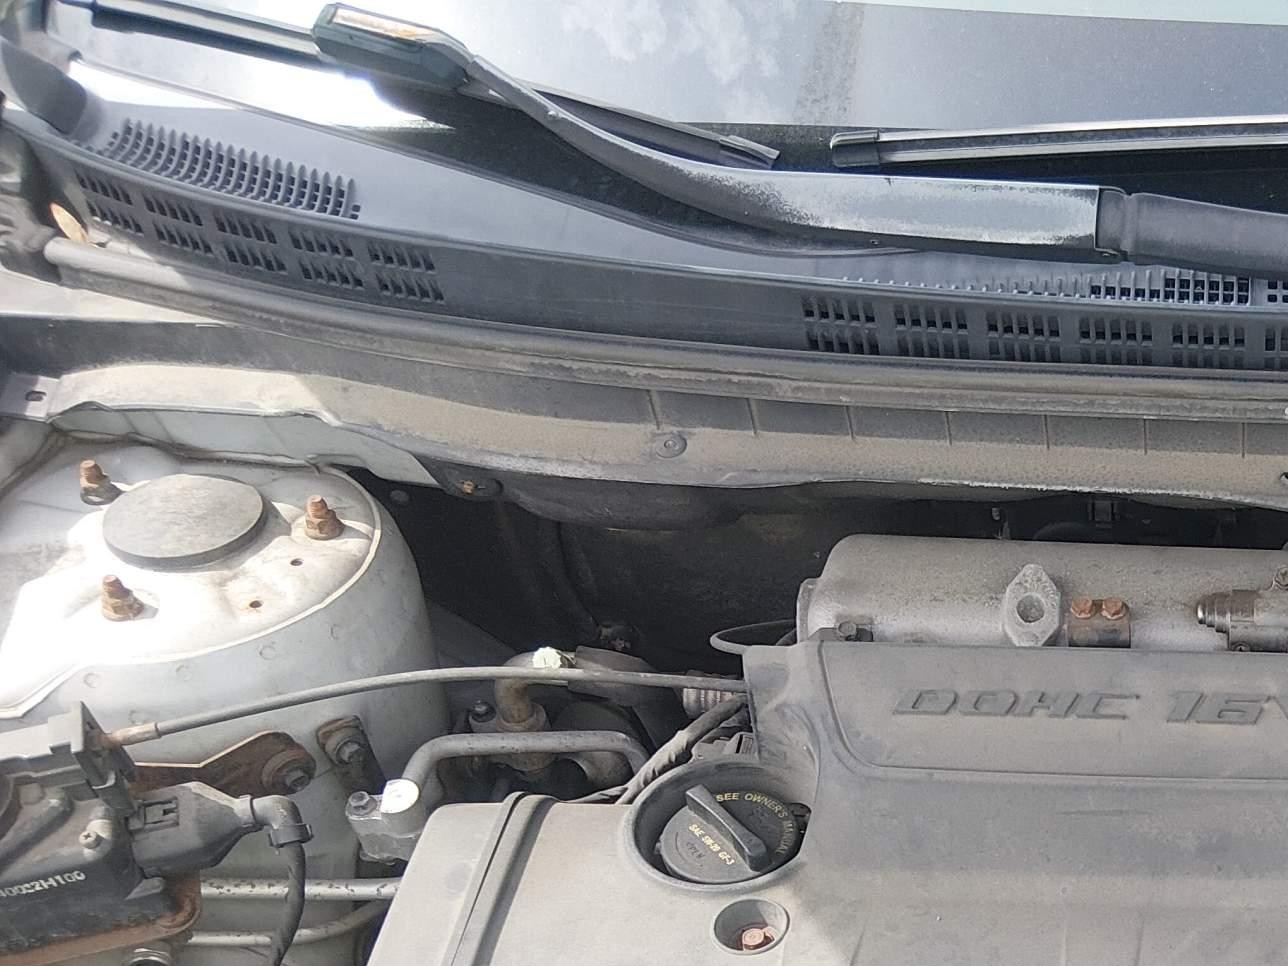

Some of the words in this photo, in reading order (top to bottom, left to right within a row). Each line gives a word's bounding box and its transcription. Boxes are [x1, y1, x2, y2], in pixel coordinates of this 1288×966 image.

[893, 690, 1140, 720] DOHC
[716, 793, 740, 803] SEE
[744, 792, 789, 819] OWNER'S
